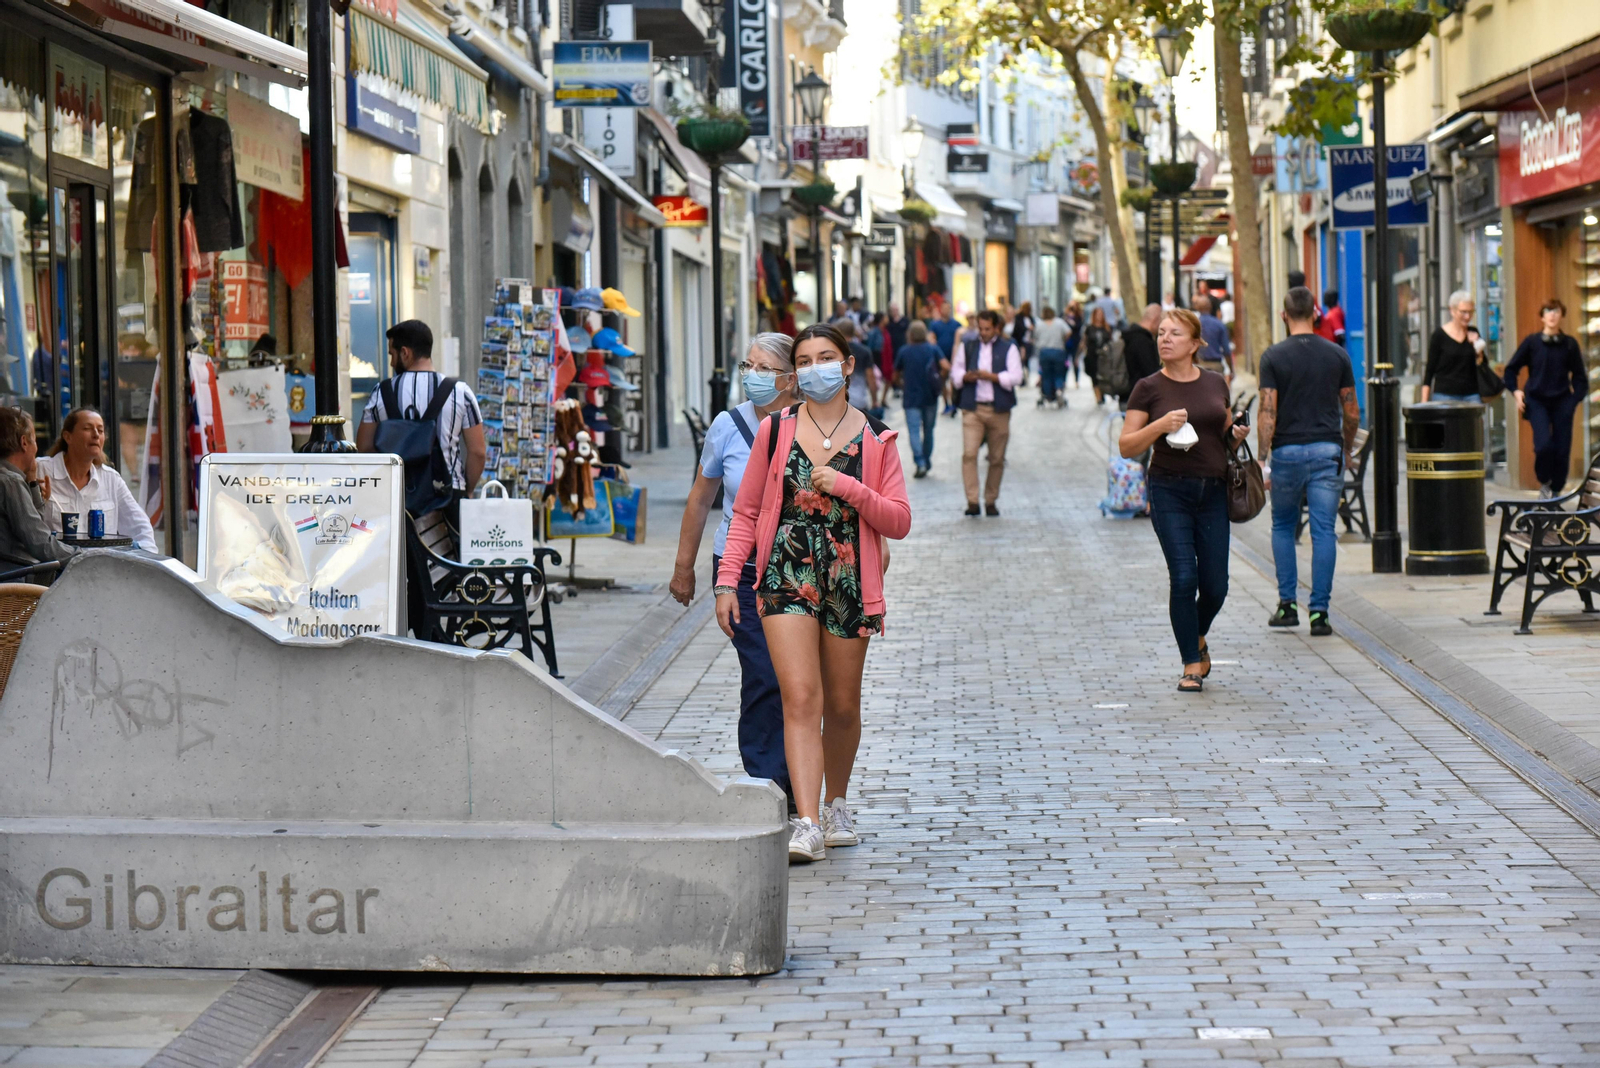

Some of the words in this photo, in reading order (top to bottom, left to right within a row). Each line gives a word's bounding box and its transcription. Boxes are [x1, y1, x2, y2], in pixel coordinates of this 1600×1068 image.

[581, 46, 622, 63] EPM
[1332, 147, 1424, 166] MARUEZ
[866, 229, 894, 245] Dior
[218, 475, 321, 487] VANDAFUL
[331, 477, 382, 488] SOFT
[246, 494, 276, 504] ICE
[286, 494, 352, 505] CREAM
[471, 538, 523, 548] Morrisons
[287, 615, 381, 640] Madagascar
[36, 867, 381, 935] Gibraltar
